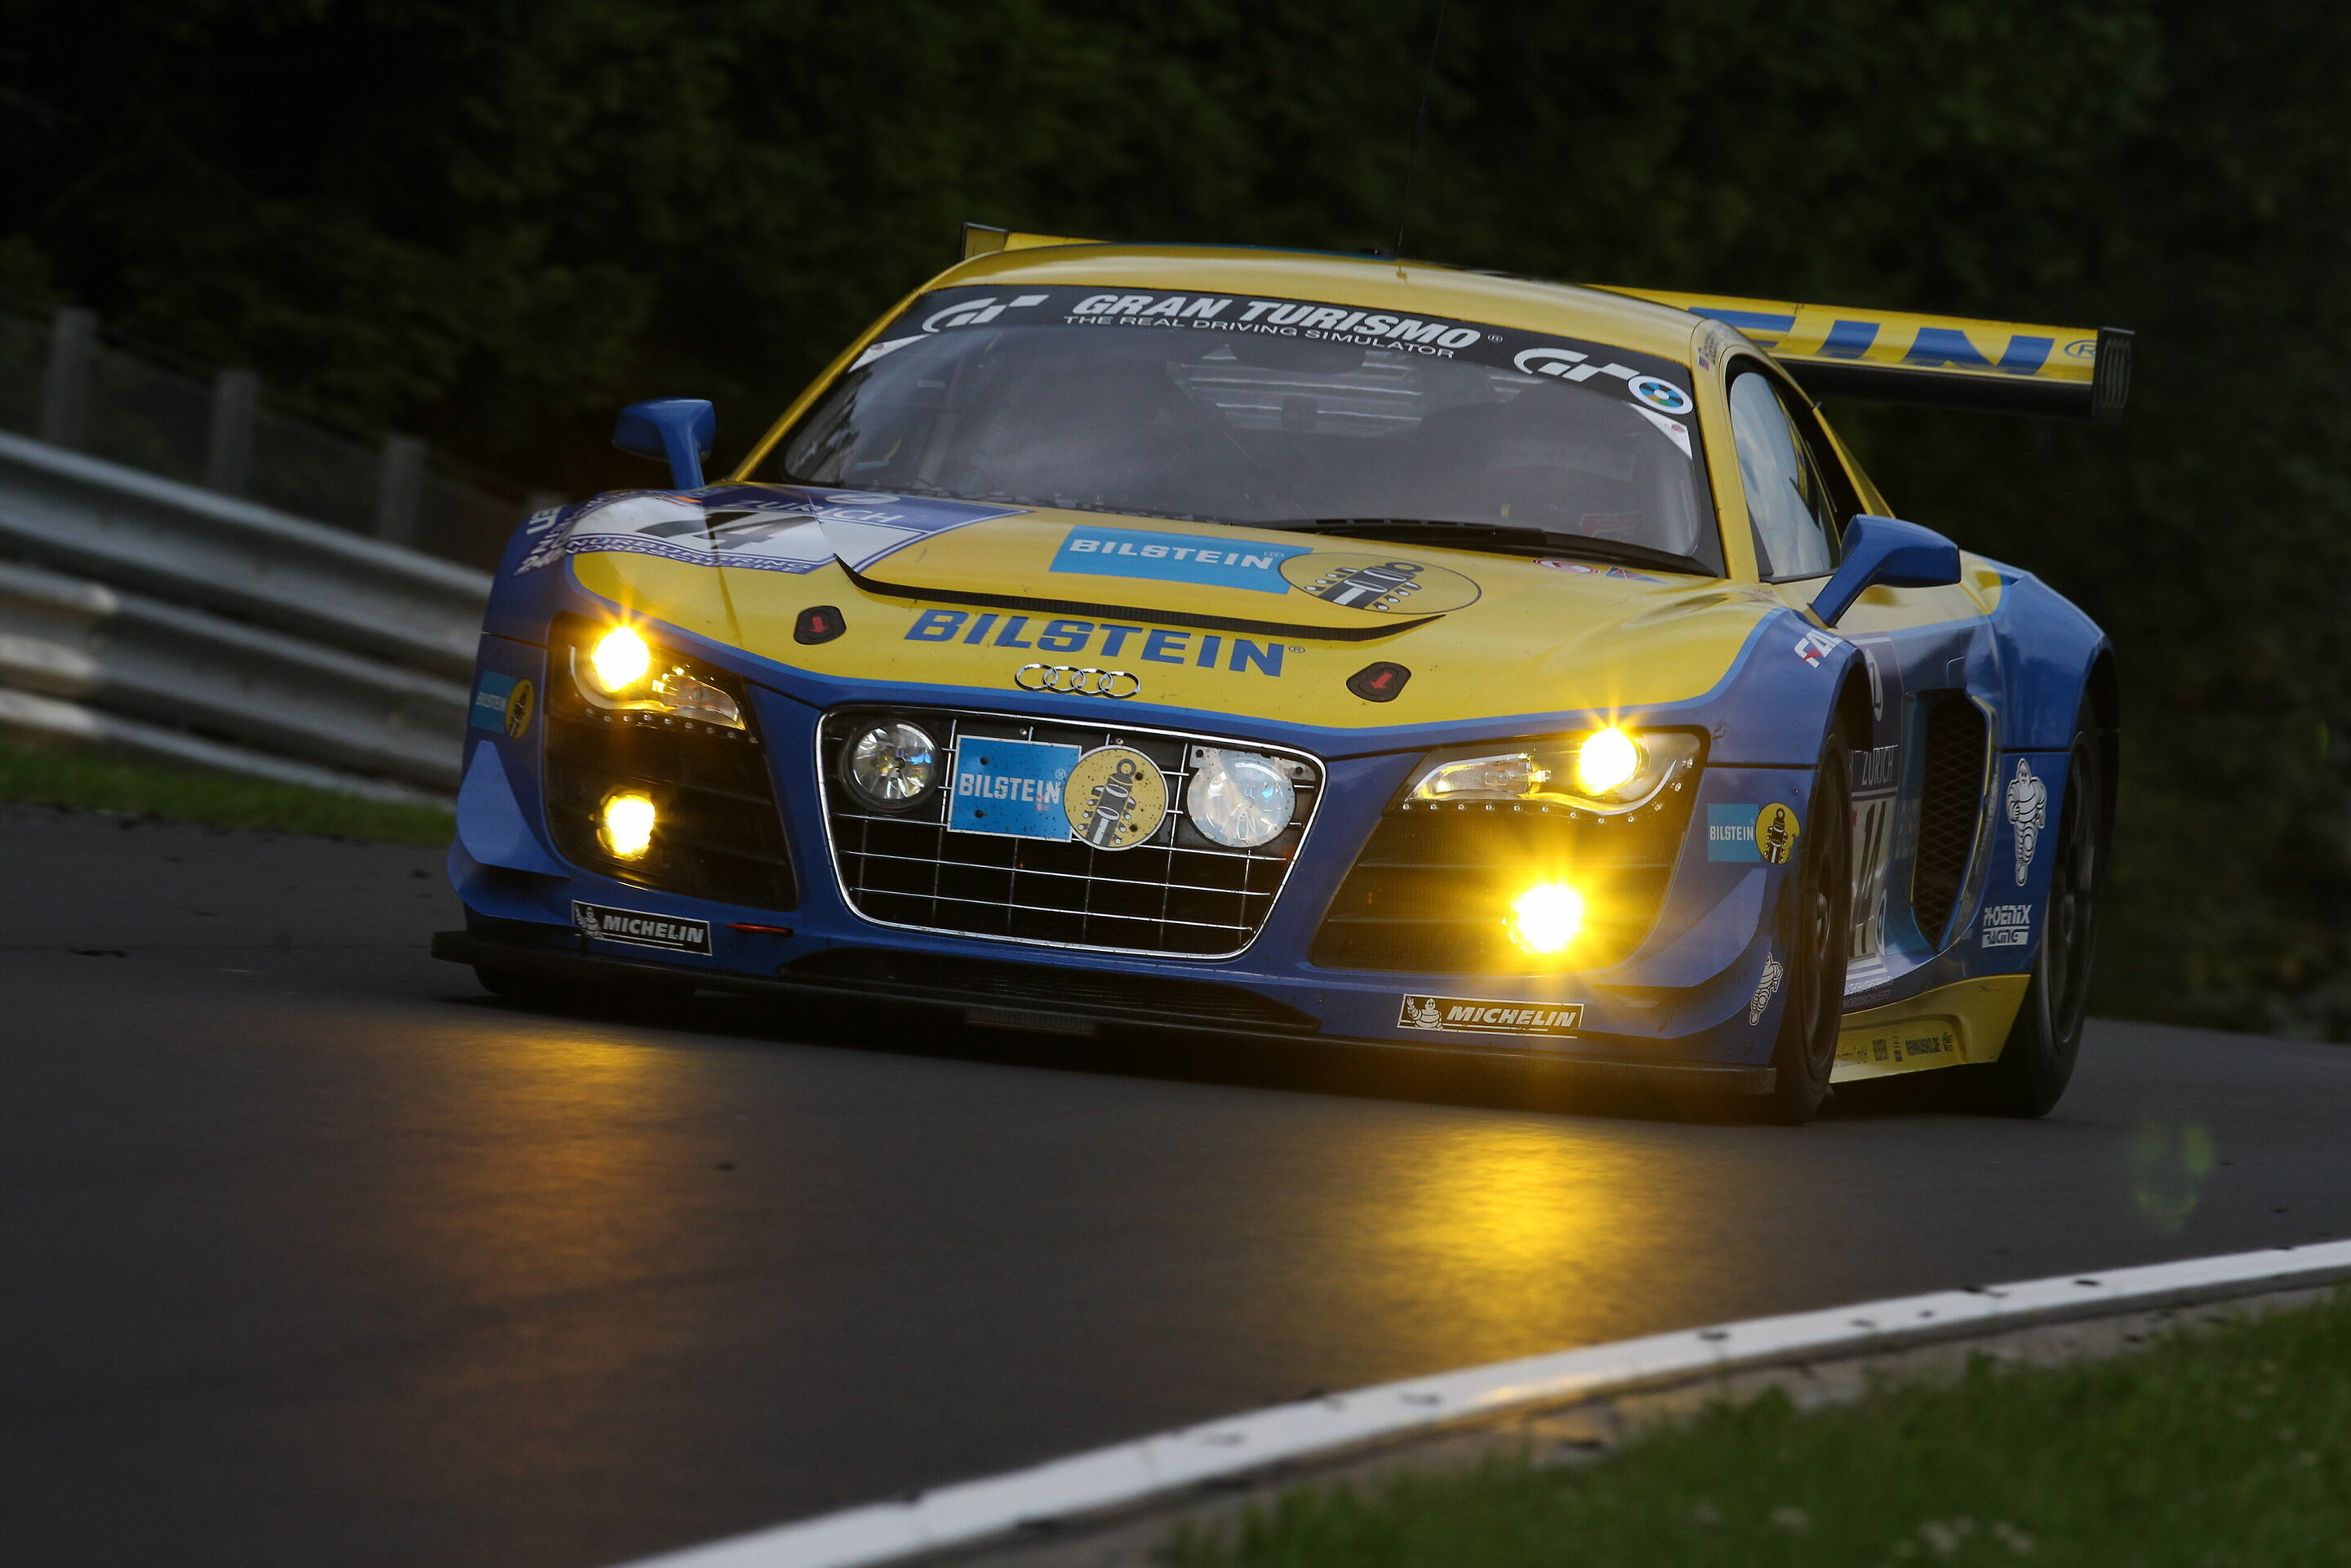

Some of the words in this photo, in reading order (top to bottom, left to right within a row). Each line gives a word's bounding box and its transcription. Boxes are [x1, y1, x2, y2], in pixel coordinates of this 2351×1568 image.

[1064, 316, 1113, 325] THE
[1119, 317, 1185, 327] REAL
[1193, 319, 1298, 336] DRIVING
[1304, 329, 1455, 358] SIMULATOR
[1072, 294, 1233, 318] GRAN
[1239, 301, 1481, 349] TURISMO
[1069, 539, 1273, 570] BILSTEIN
[904, 609, 1285, 677] BILSTEIN
[958, 773, 1060, 804] BILSTEIN
[1710, 825, 1753, 841] BILSTEIN
[602, 915, 704, 943] MICHELIN
[1447, 1006, 1576, 1027] MICHELIN
